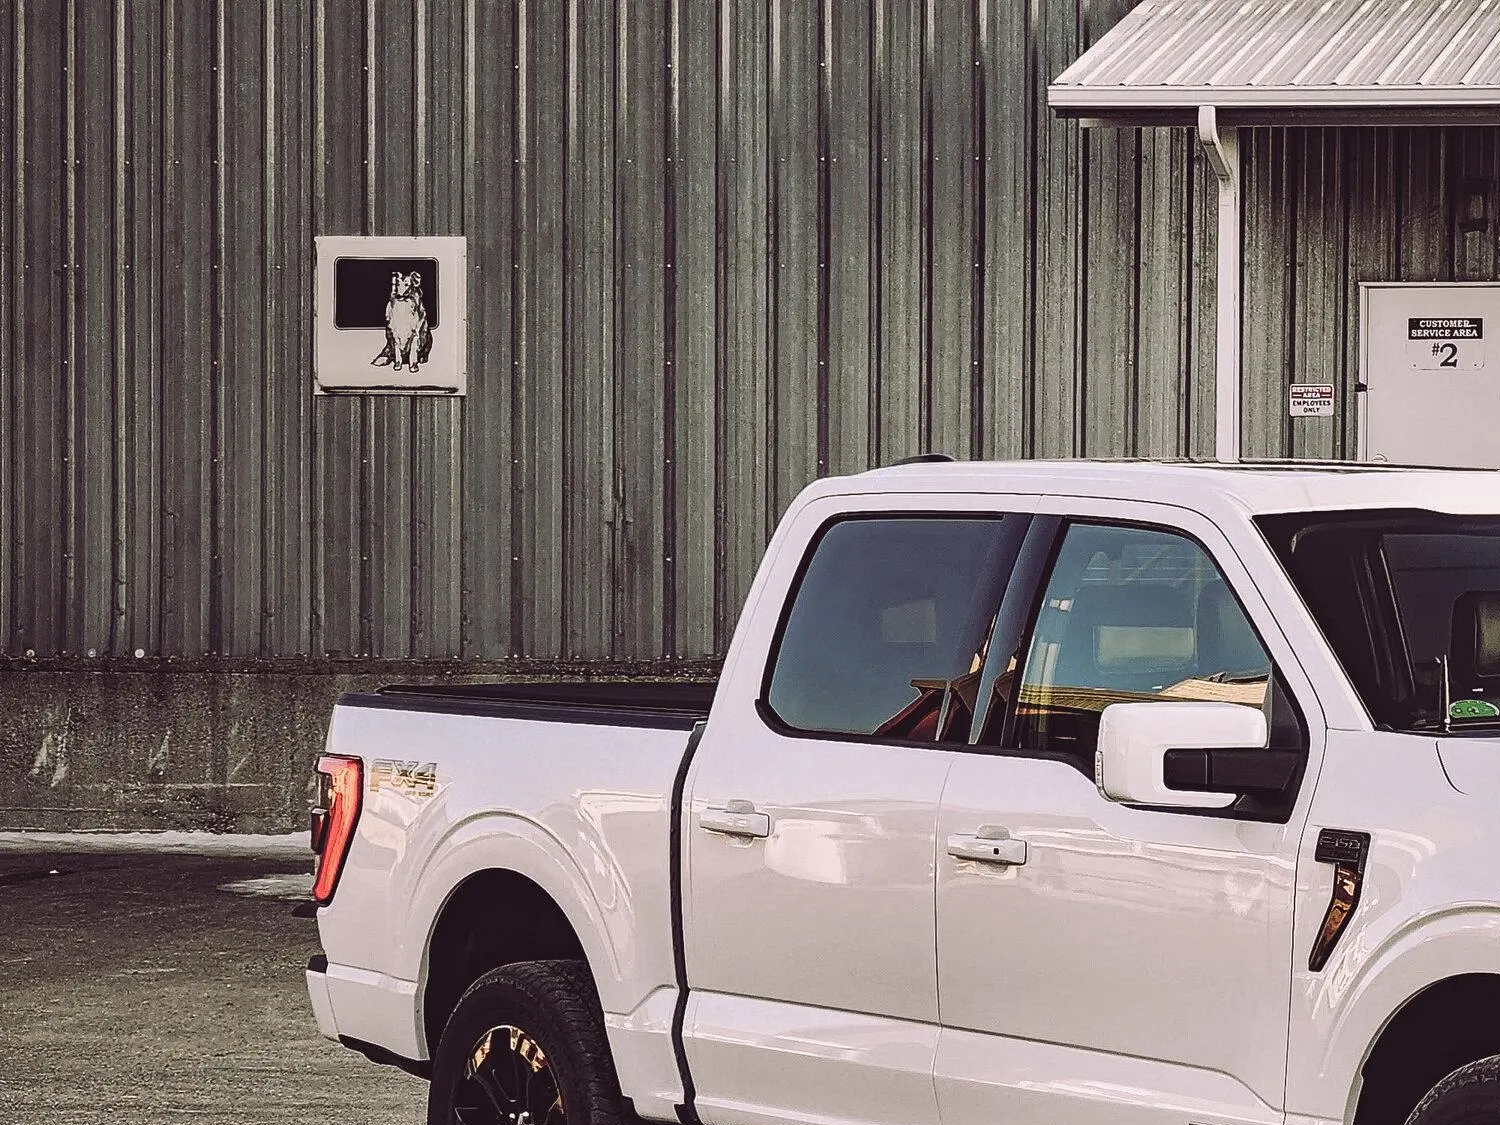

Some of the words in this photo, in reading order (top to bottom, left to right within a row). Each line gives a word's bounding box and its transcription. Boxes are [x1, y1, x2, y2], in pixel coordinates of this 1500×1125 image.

[1419, 319, 1477, 328] CUSTOMER
[1411, 329, 1451, 338] SERVICE
[1452, 329, 1478, 337] AREA
[1431, 342, 1458, 368] #2
[370, 758, 438, 793] FX4
